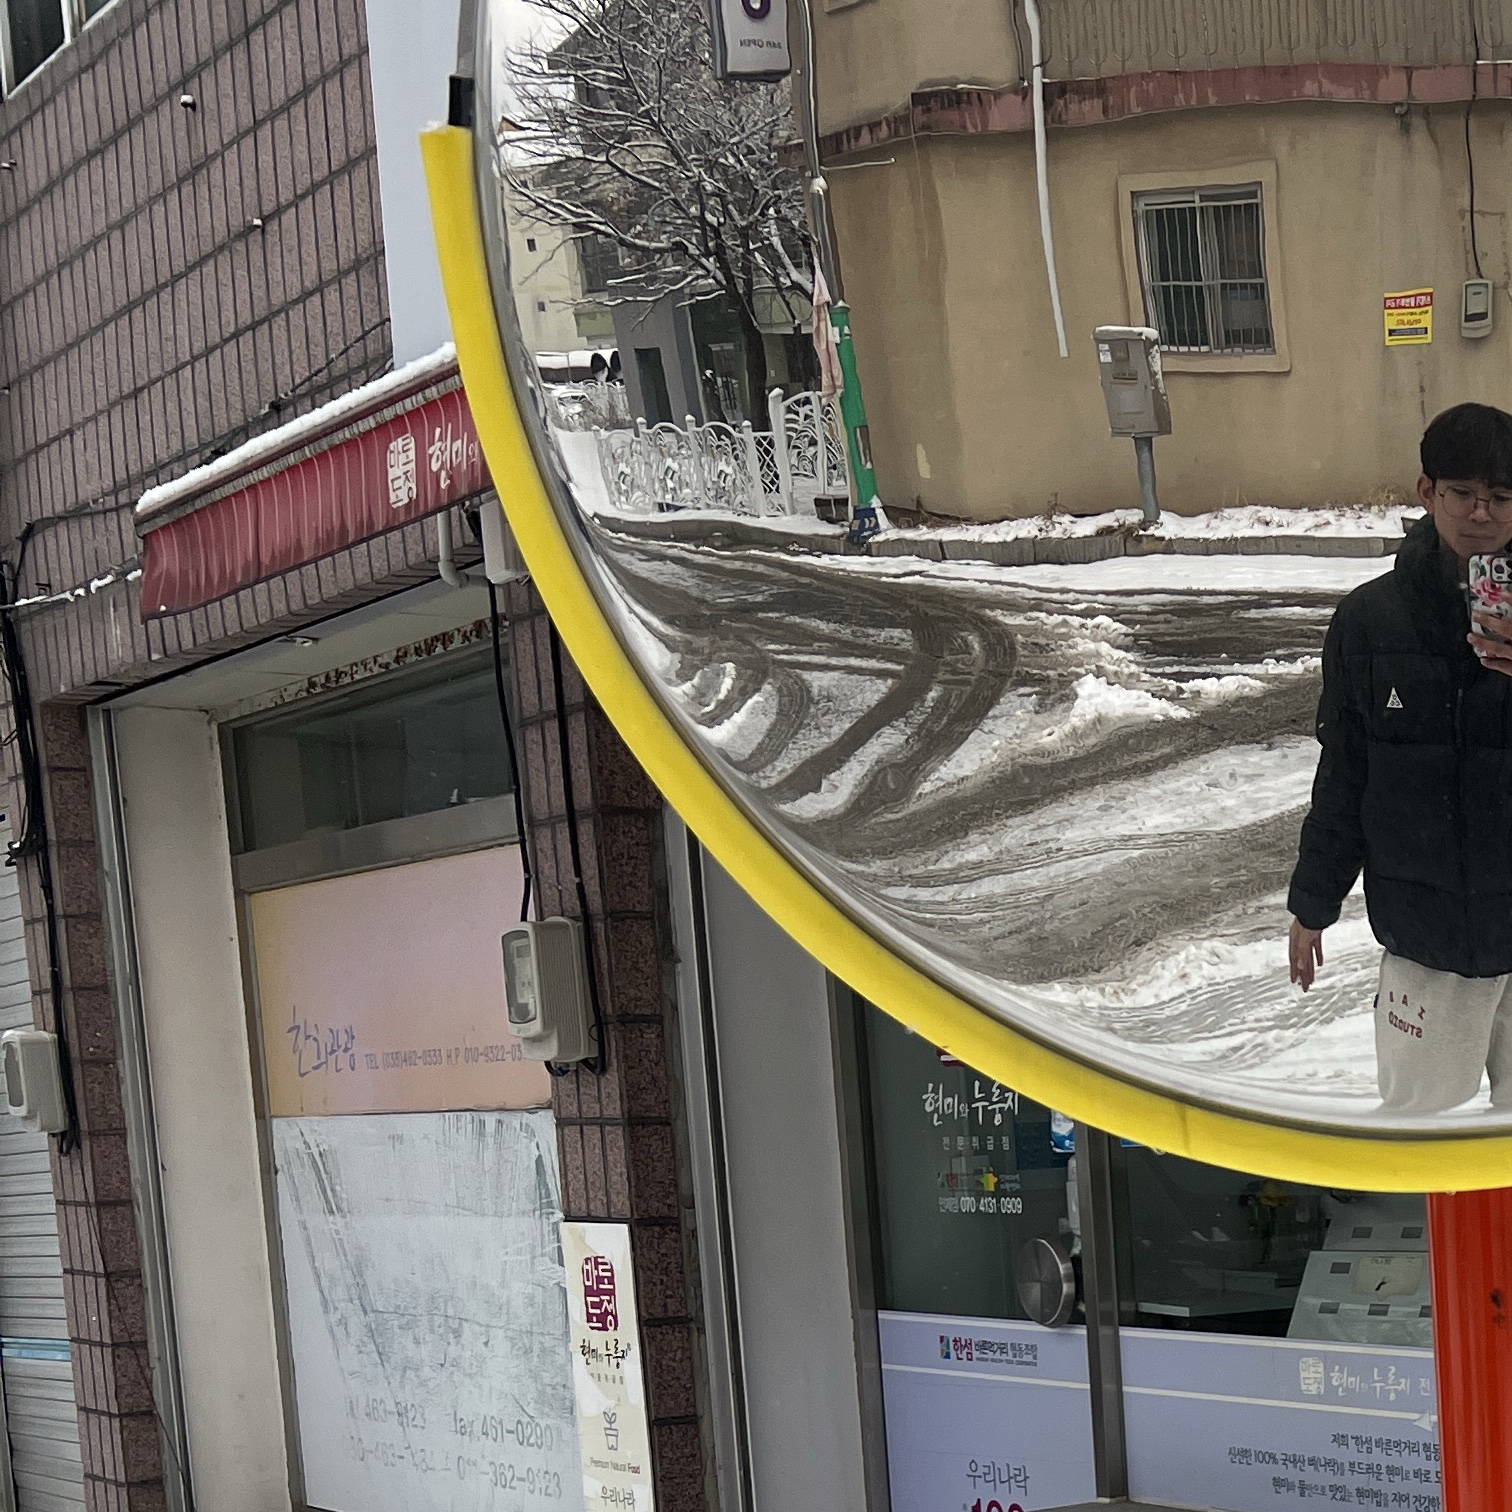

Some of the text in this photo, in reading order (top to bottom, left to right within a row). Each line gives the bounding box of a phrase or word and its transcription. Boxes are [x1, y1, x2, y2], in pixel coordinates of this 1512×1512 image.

[464, 1043, 523, 1065] 010-9322-03
[922, 1080, 1019, 1127] 현미와 누룽지
[952, 1337, 974, 1361] 한섬
[1369, 1365, 1411, 1402] 누룽지
[1331, 1432, 1350, 1450] 저희
[1374, 1437, 1421, 1458] 바른먹거리
[966, 1459, 1031, 1497] 우리나락
[1254, 1450, 1279, 1466] 100%
[1280, 1452, 1306, 1473] 국내산
[1348, 1461, 1385, 1482] 부드러운
[1385, 1464, 1412, 1484] 현미로
[1413, 1467, 1433, 1485] 바로
[600, 1485, 636, 1512] 우리나라
[1391, 1491, 1411, 1510] 지어
